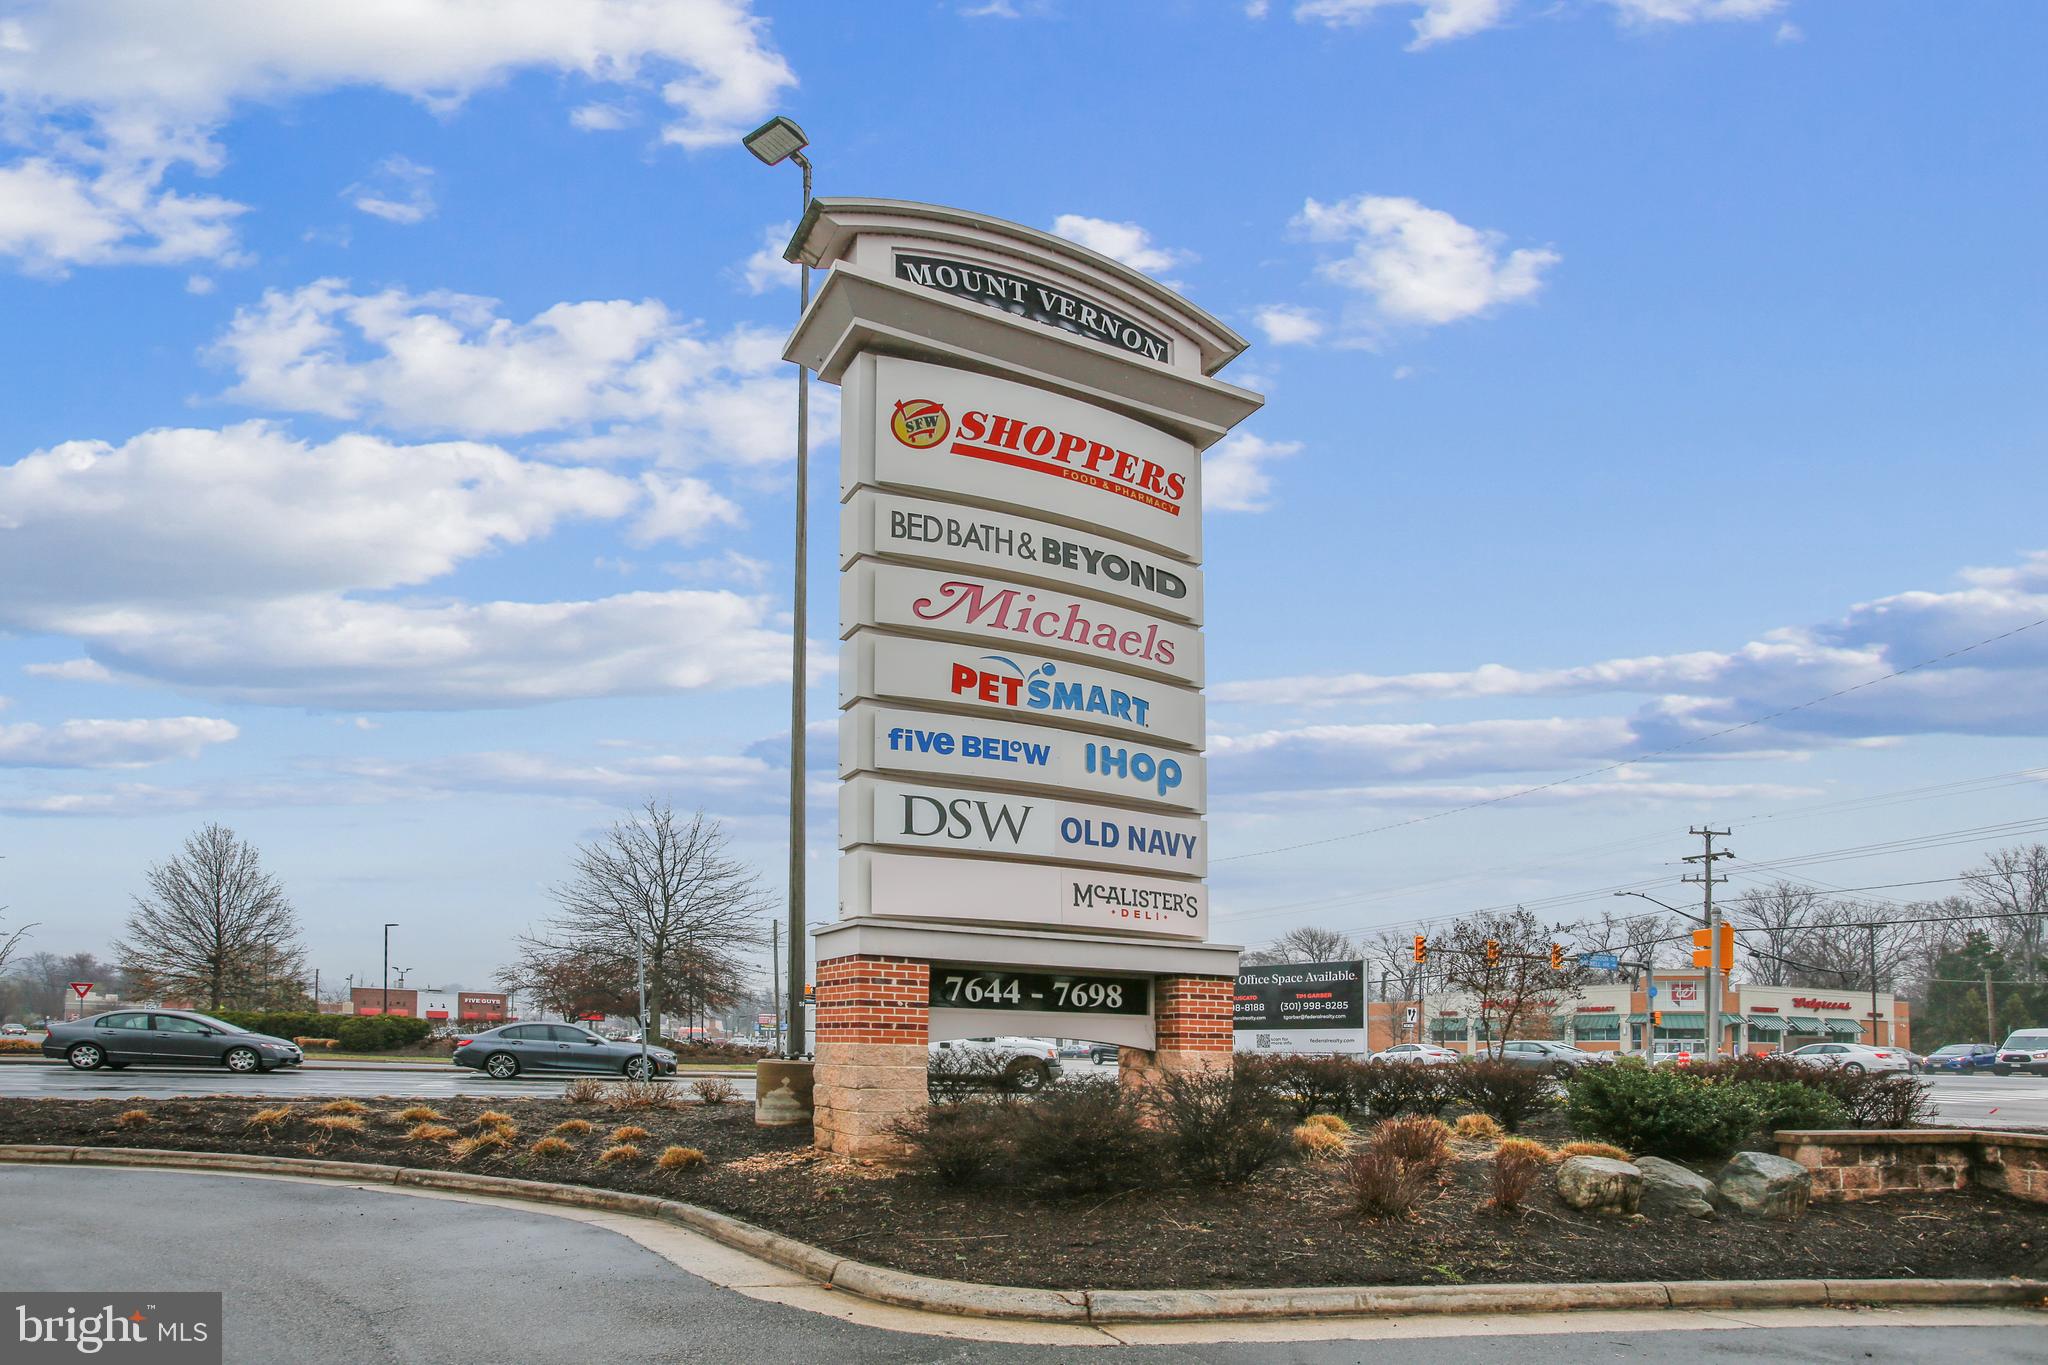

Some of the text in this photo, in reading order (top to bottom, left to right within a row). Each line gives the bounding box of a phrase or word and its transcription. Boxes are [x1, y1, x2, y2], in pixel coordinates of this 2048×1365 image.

[902, 262, 1167, 361] MOUNT VERNON
[905, 415, 940, 433] SFW
[955, 410, 1186, 501] SHOPPERS
[1063, 469, 1176, 513] FOOD & PHARMACY
[890, 510, 1187, 600] BED BATH & BEYOND
[912, 580, 1176, 666] Michaels
[899, 793, 1034, 845] DSW
[1060, 816, 1197, 859] OLD NAVY
[944, 976, 1021, 1004] 7644
[1052, 982, 1123, 1009] 7698
[1238, 974, 1270, 986] Office
[1271, 973, 1303, 986] Space
[1305, 970, 1358, 983] Available.
[1232, 1003, 1265, 1012] 8-8188
[1280, 1001, 1349, 1013] (301) 998-8285
